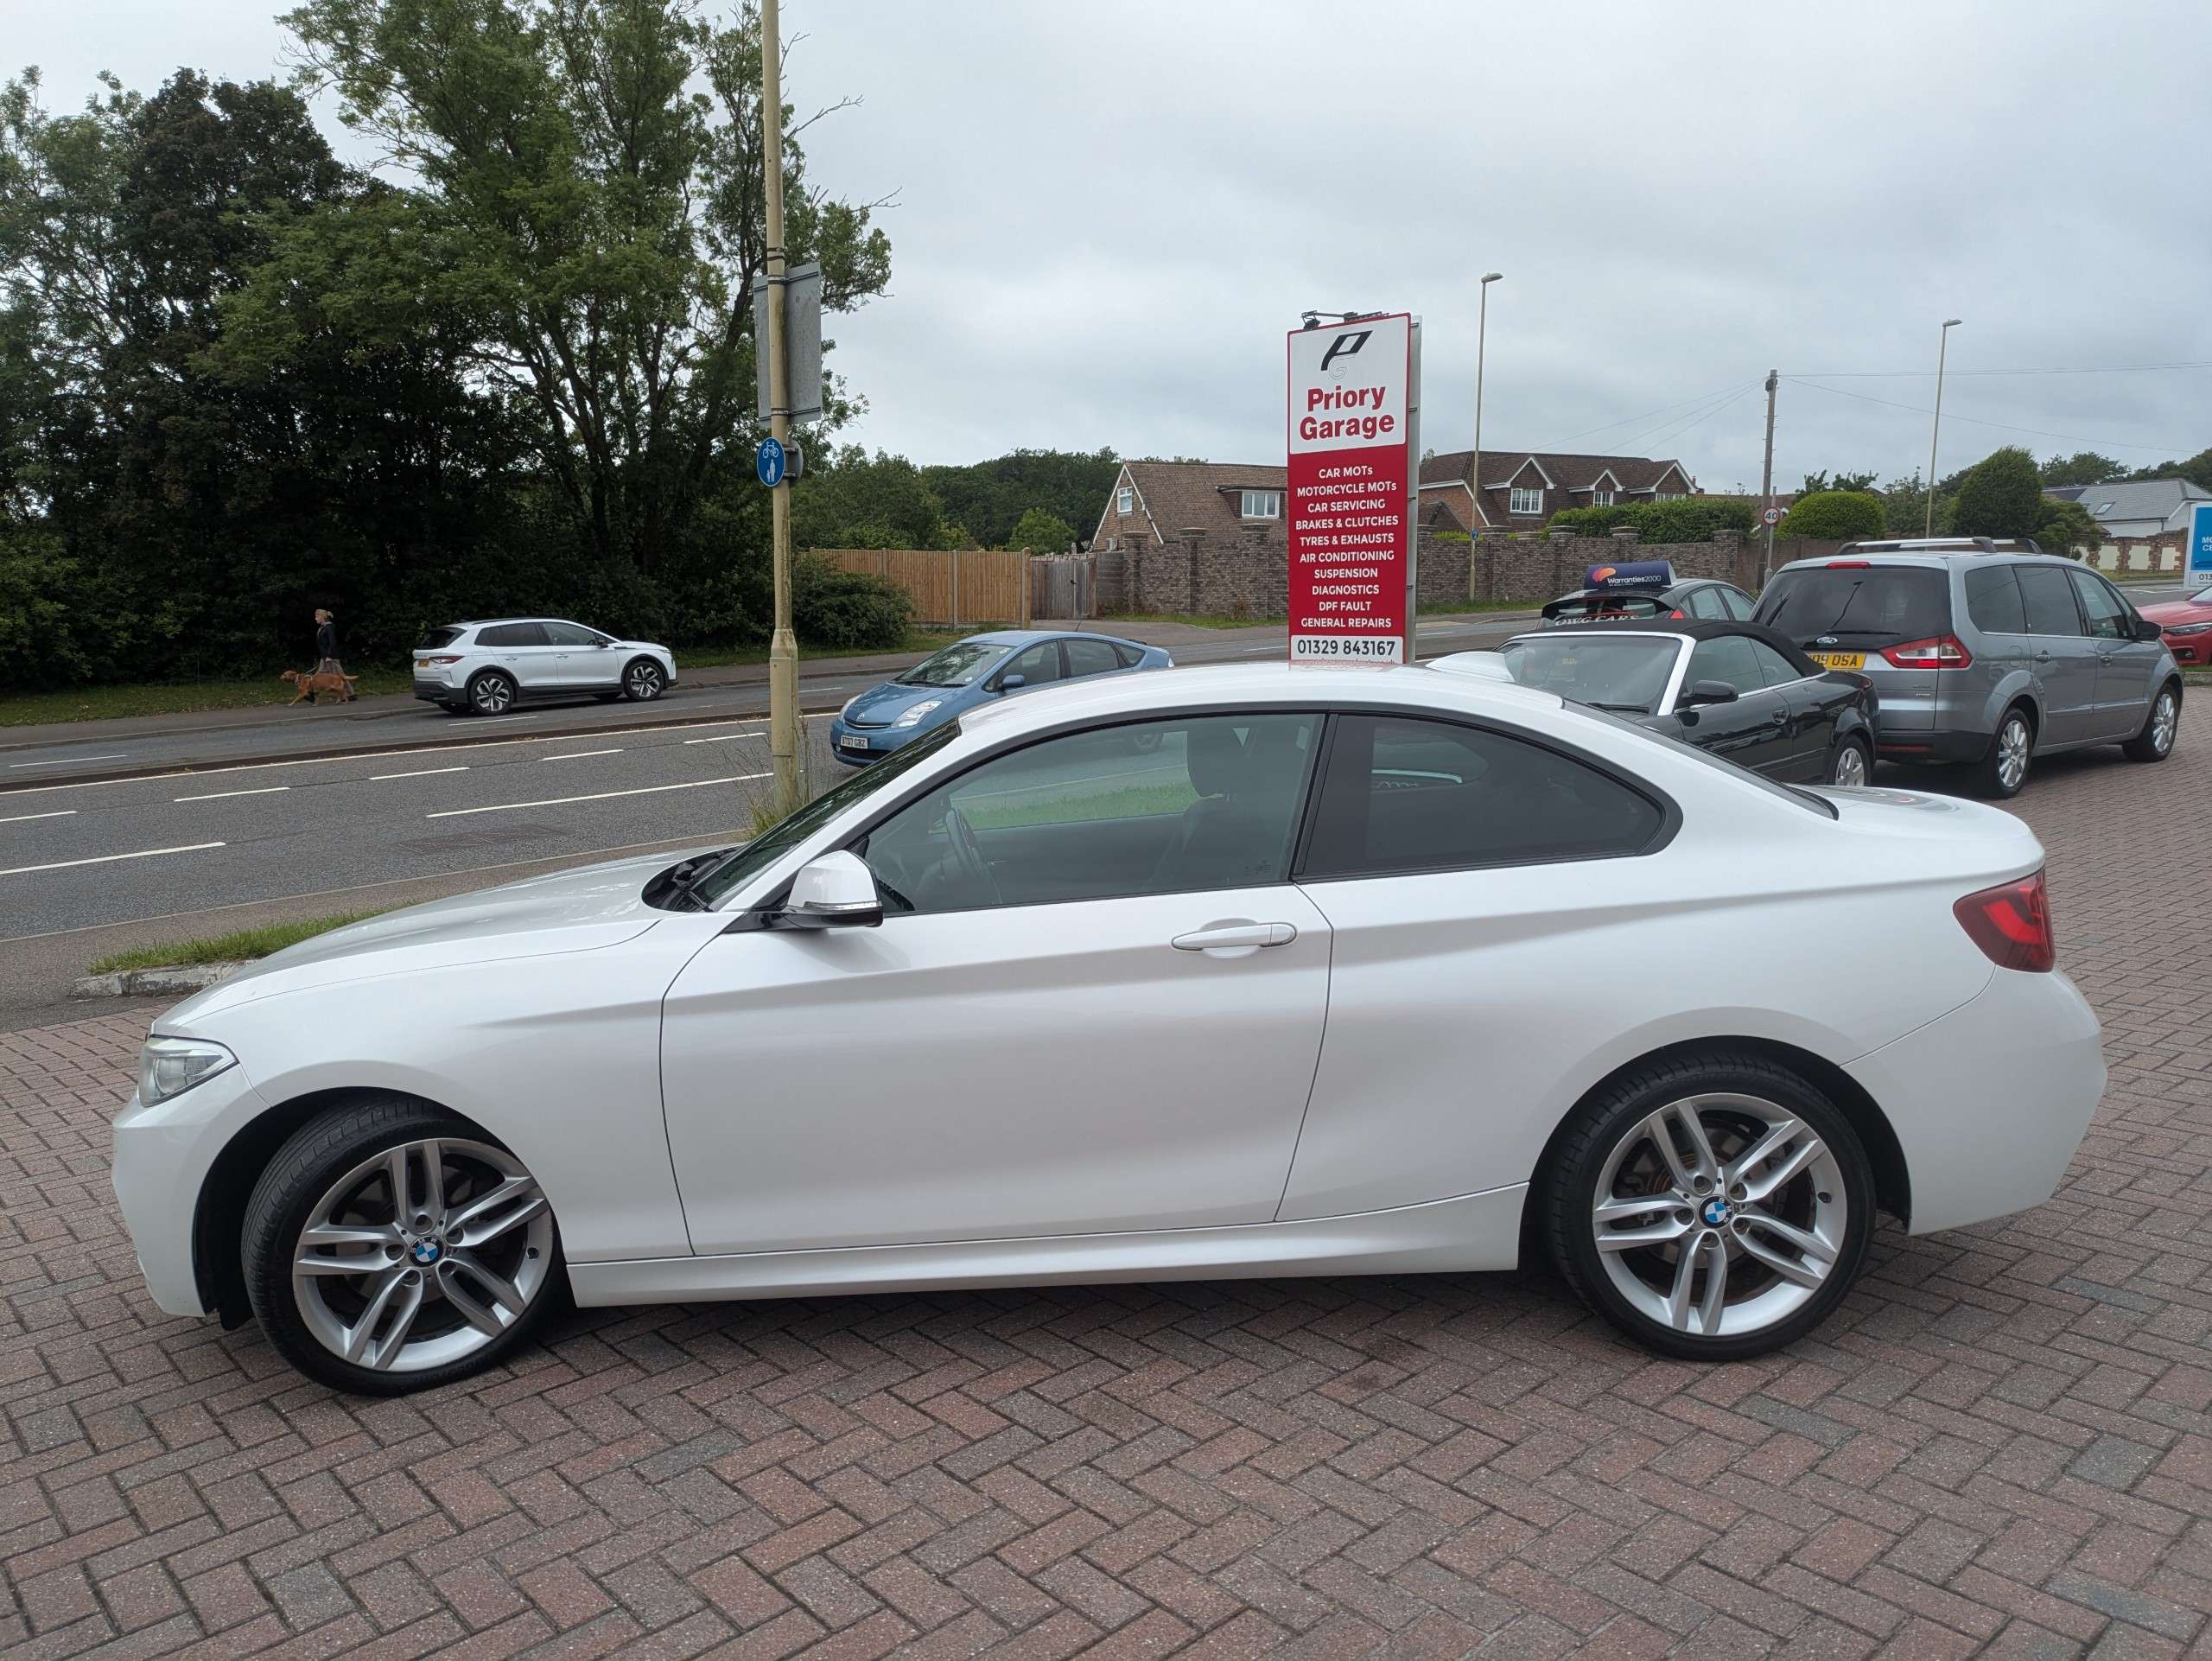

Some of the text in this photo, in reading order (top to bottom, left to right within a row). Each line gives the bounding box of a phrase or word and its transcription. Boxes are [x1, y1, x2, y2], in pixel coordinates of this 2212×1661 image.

[1307, 385, 1386, 412] Priory
[1300, 414, 1395, 441] Garage
[1319, 465, 1374, 479] CAR MOTs
[1297, 481, 1397, 498] MOTORCYCLE MOTs
[1307, 499, 1386, 513] CAR SERVICING
[1296, 515, 1399, 530] BRAKES & CLUTCHES
[1764, 512, 1778, 520] 40
[1300, 533, 1395, 547] TYRES & EXHAUSTS
[1300, 550, 1395, 563] AIR CONDITIONING
[1314, 568, 1378, 579] SUSPENSION
[1607, 575, 1662, 584] Warranties2000
[1312, 584, 1380, 595] DIAGNOSTICS
[1319, 601, 1372, 611] DPF FAULT
[1300, 617, 1392, 628] GENERAL REPAIRS
[1297, 639, 1395, 656] 01329 843167
